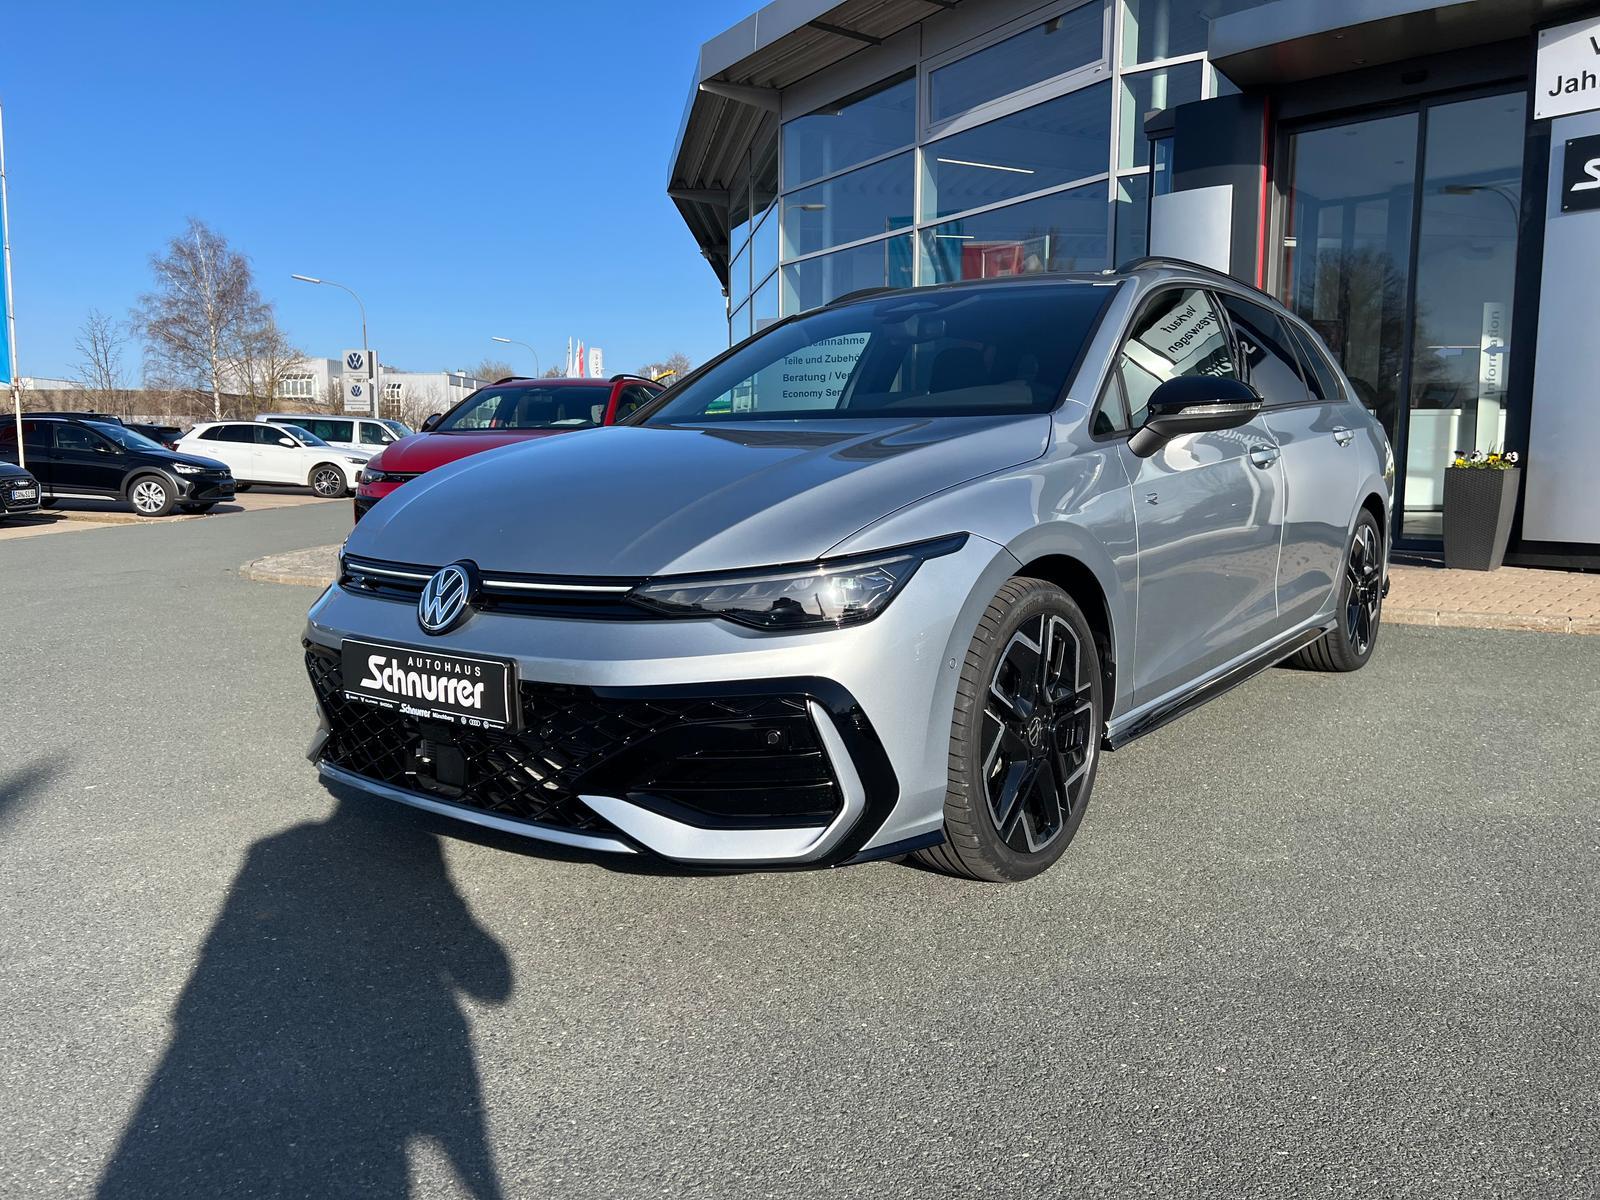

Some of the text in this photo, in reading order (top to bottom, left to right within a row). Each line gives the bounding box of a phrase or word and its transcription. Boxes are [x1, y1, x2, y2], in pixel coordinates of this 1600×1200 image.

[1549, 70, 1600, 97] Jah
[783, 356, 803, 365] Teile
[805, 355, 822, 364] und
[783, 372, 825, 382] Beratung
[782, 389, 823, 399] Economy
[407, 656, 481, 677] AUTOHAUS
[360, 655, 484, 709] Schnurrer
